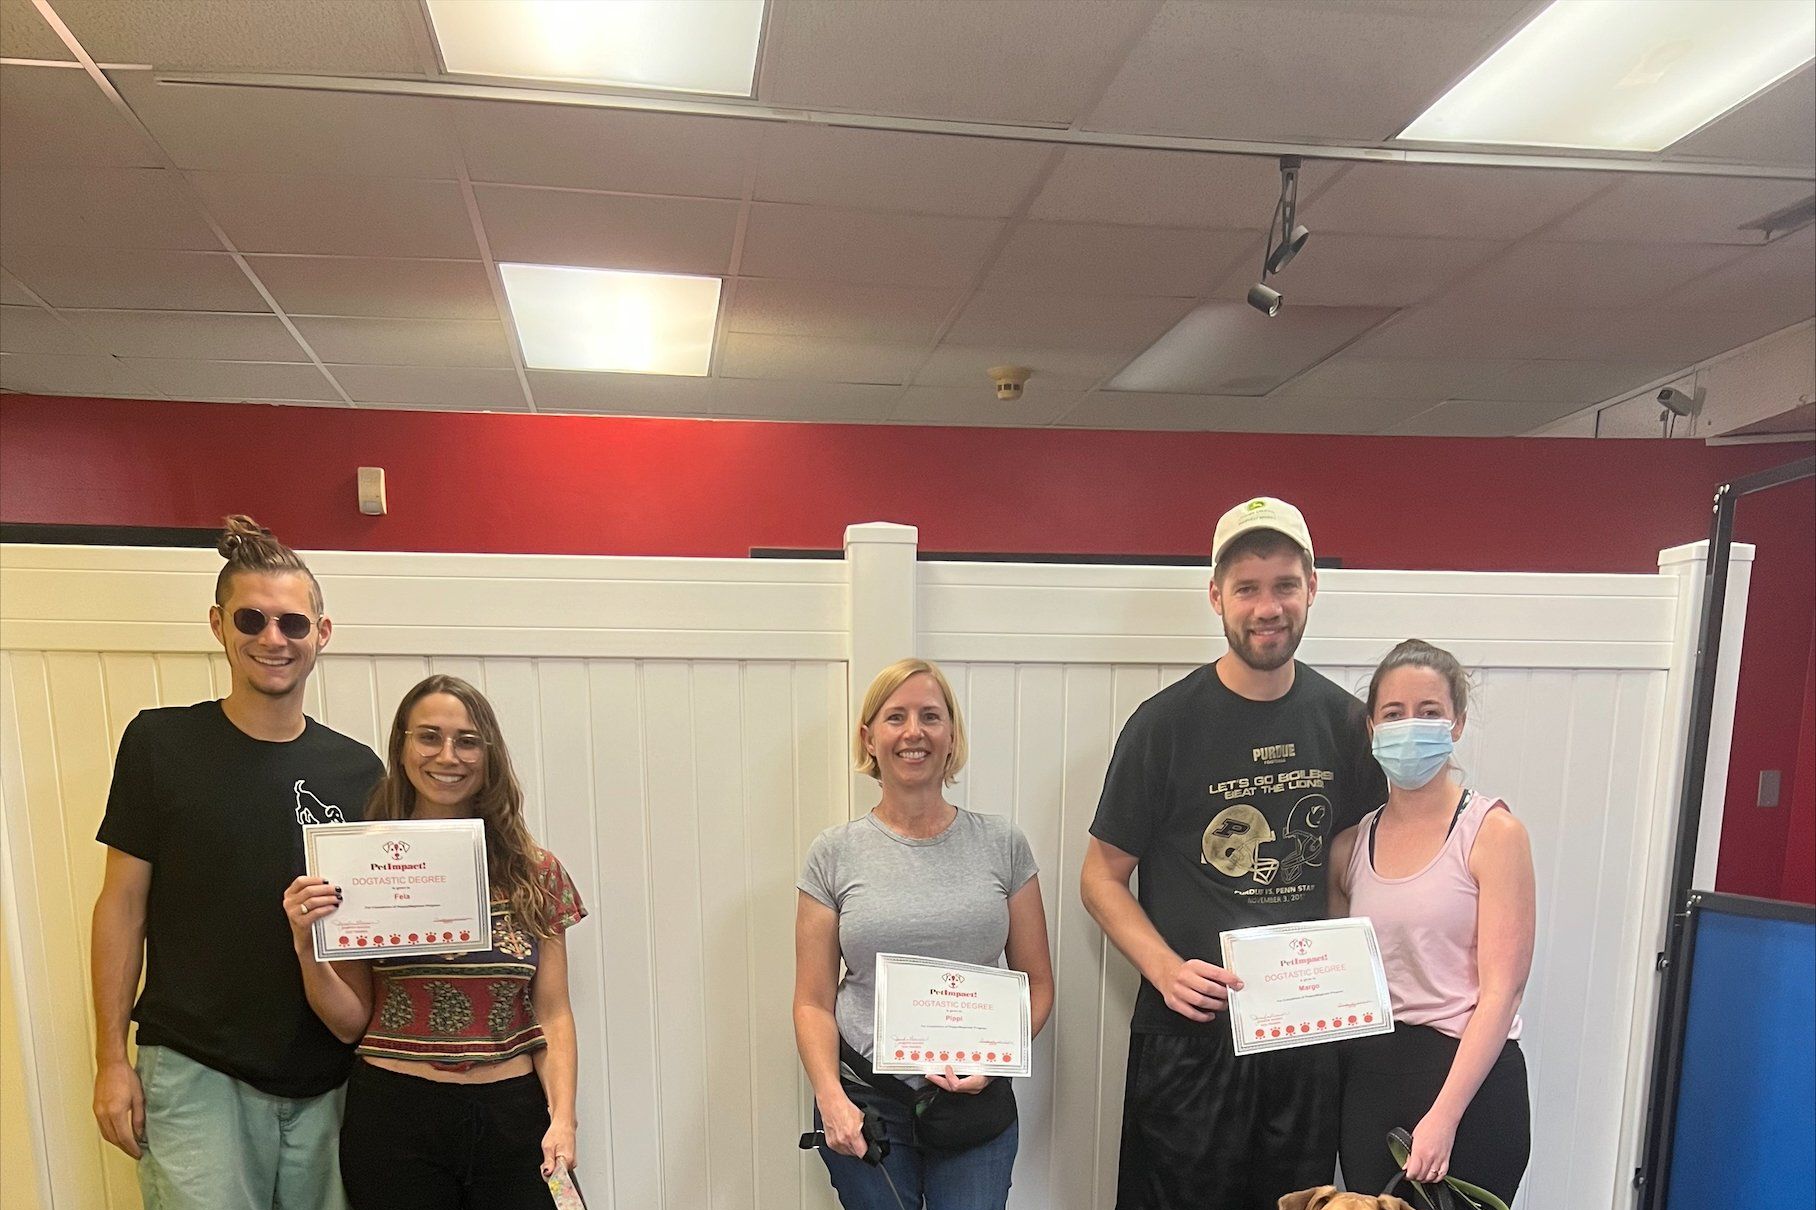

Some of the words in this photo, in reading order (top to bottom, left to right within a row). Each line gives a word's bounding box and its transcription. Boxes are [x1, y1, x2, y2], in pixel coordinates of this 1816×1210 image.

[1252, 743, 1296, 762] PURDUE
[1209, 778, 1250, 794] LET'S
[1254, 775, 1274, 786] GO
[1224, 787, 1257, 800] BEAT
[1261, 783, 1285, 794] THE
[371, 862, 426, 871] PetImpact!
[352, 876, 406, 885] DOGTASTIC
[408, 875, 447, 884] DEGREE
[1275, 886, 1296, 895] PENN
[1280, 954, 1328, 967] PetImpact!
[1264, 968, 1312, 983] DOGTASTIC
[1313, 963, 1346, 975] DEGREE
[1298, 983, 1320, 991] Margo
[930, 989, 977, 998] PetImpact!
[912, 999, 959, 1009] DOGTASTIC
[960, 1001, 993, 1011] DEGREE
